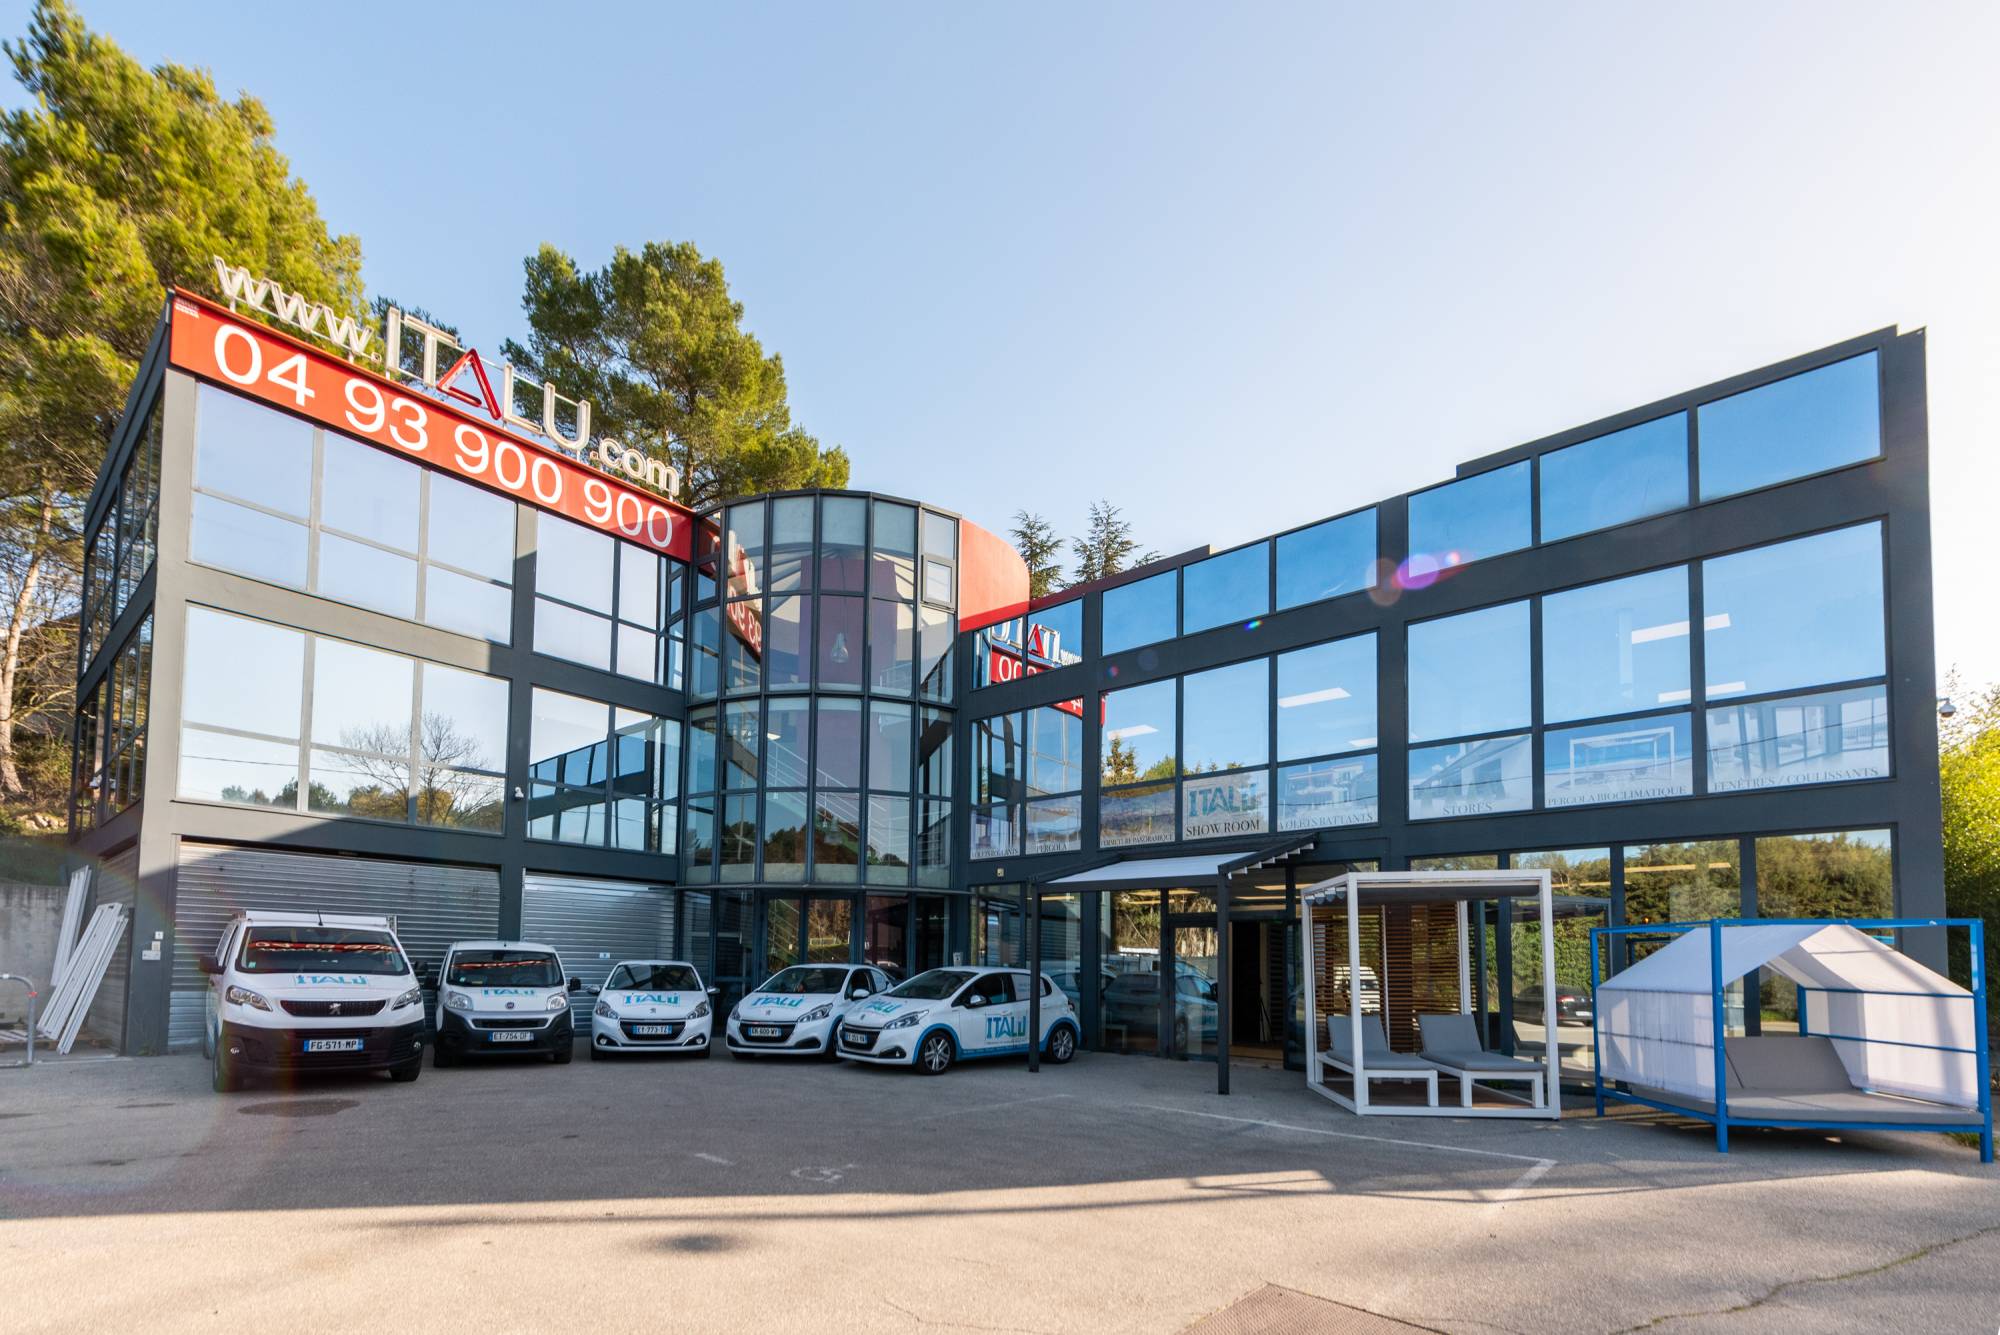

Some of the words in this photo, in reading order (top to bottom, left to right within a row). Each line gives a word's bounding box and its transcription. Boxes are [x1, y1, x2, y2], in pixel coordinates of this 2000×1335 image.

[214, 324, 315, 406] 04
[345, 378, 428, 451] 93
[455, 424, 562, 504] 900
[584, 479, 672, 548] 900
[1786, 767, 1879, 784] COULISSANTS
[1188, 784, 1258, 817] ITALU
[1548, 793, 1594, 806] PERGOLA
[1595, 786, 1687, 802] BIOCLIMATIQUE
[1442, 801, 1493, 816] STORES
[1186, 822, 1223, 838] SHOW
[1224, 819, 1260, 834] ROOM
[1320, 813, 1374, 826] BATTANTS
[1036, 842, 1067, 853] PERGOLA
[986, 1015, 1027, 1040] ITALU
